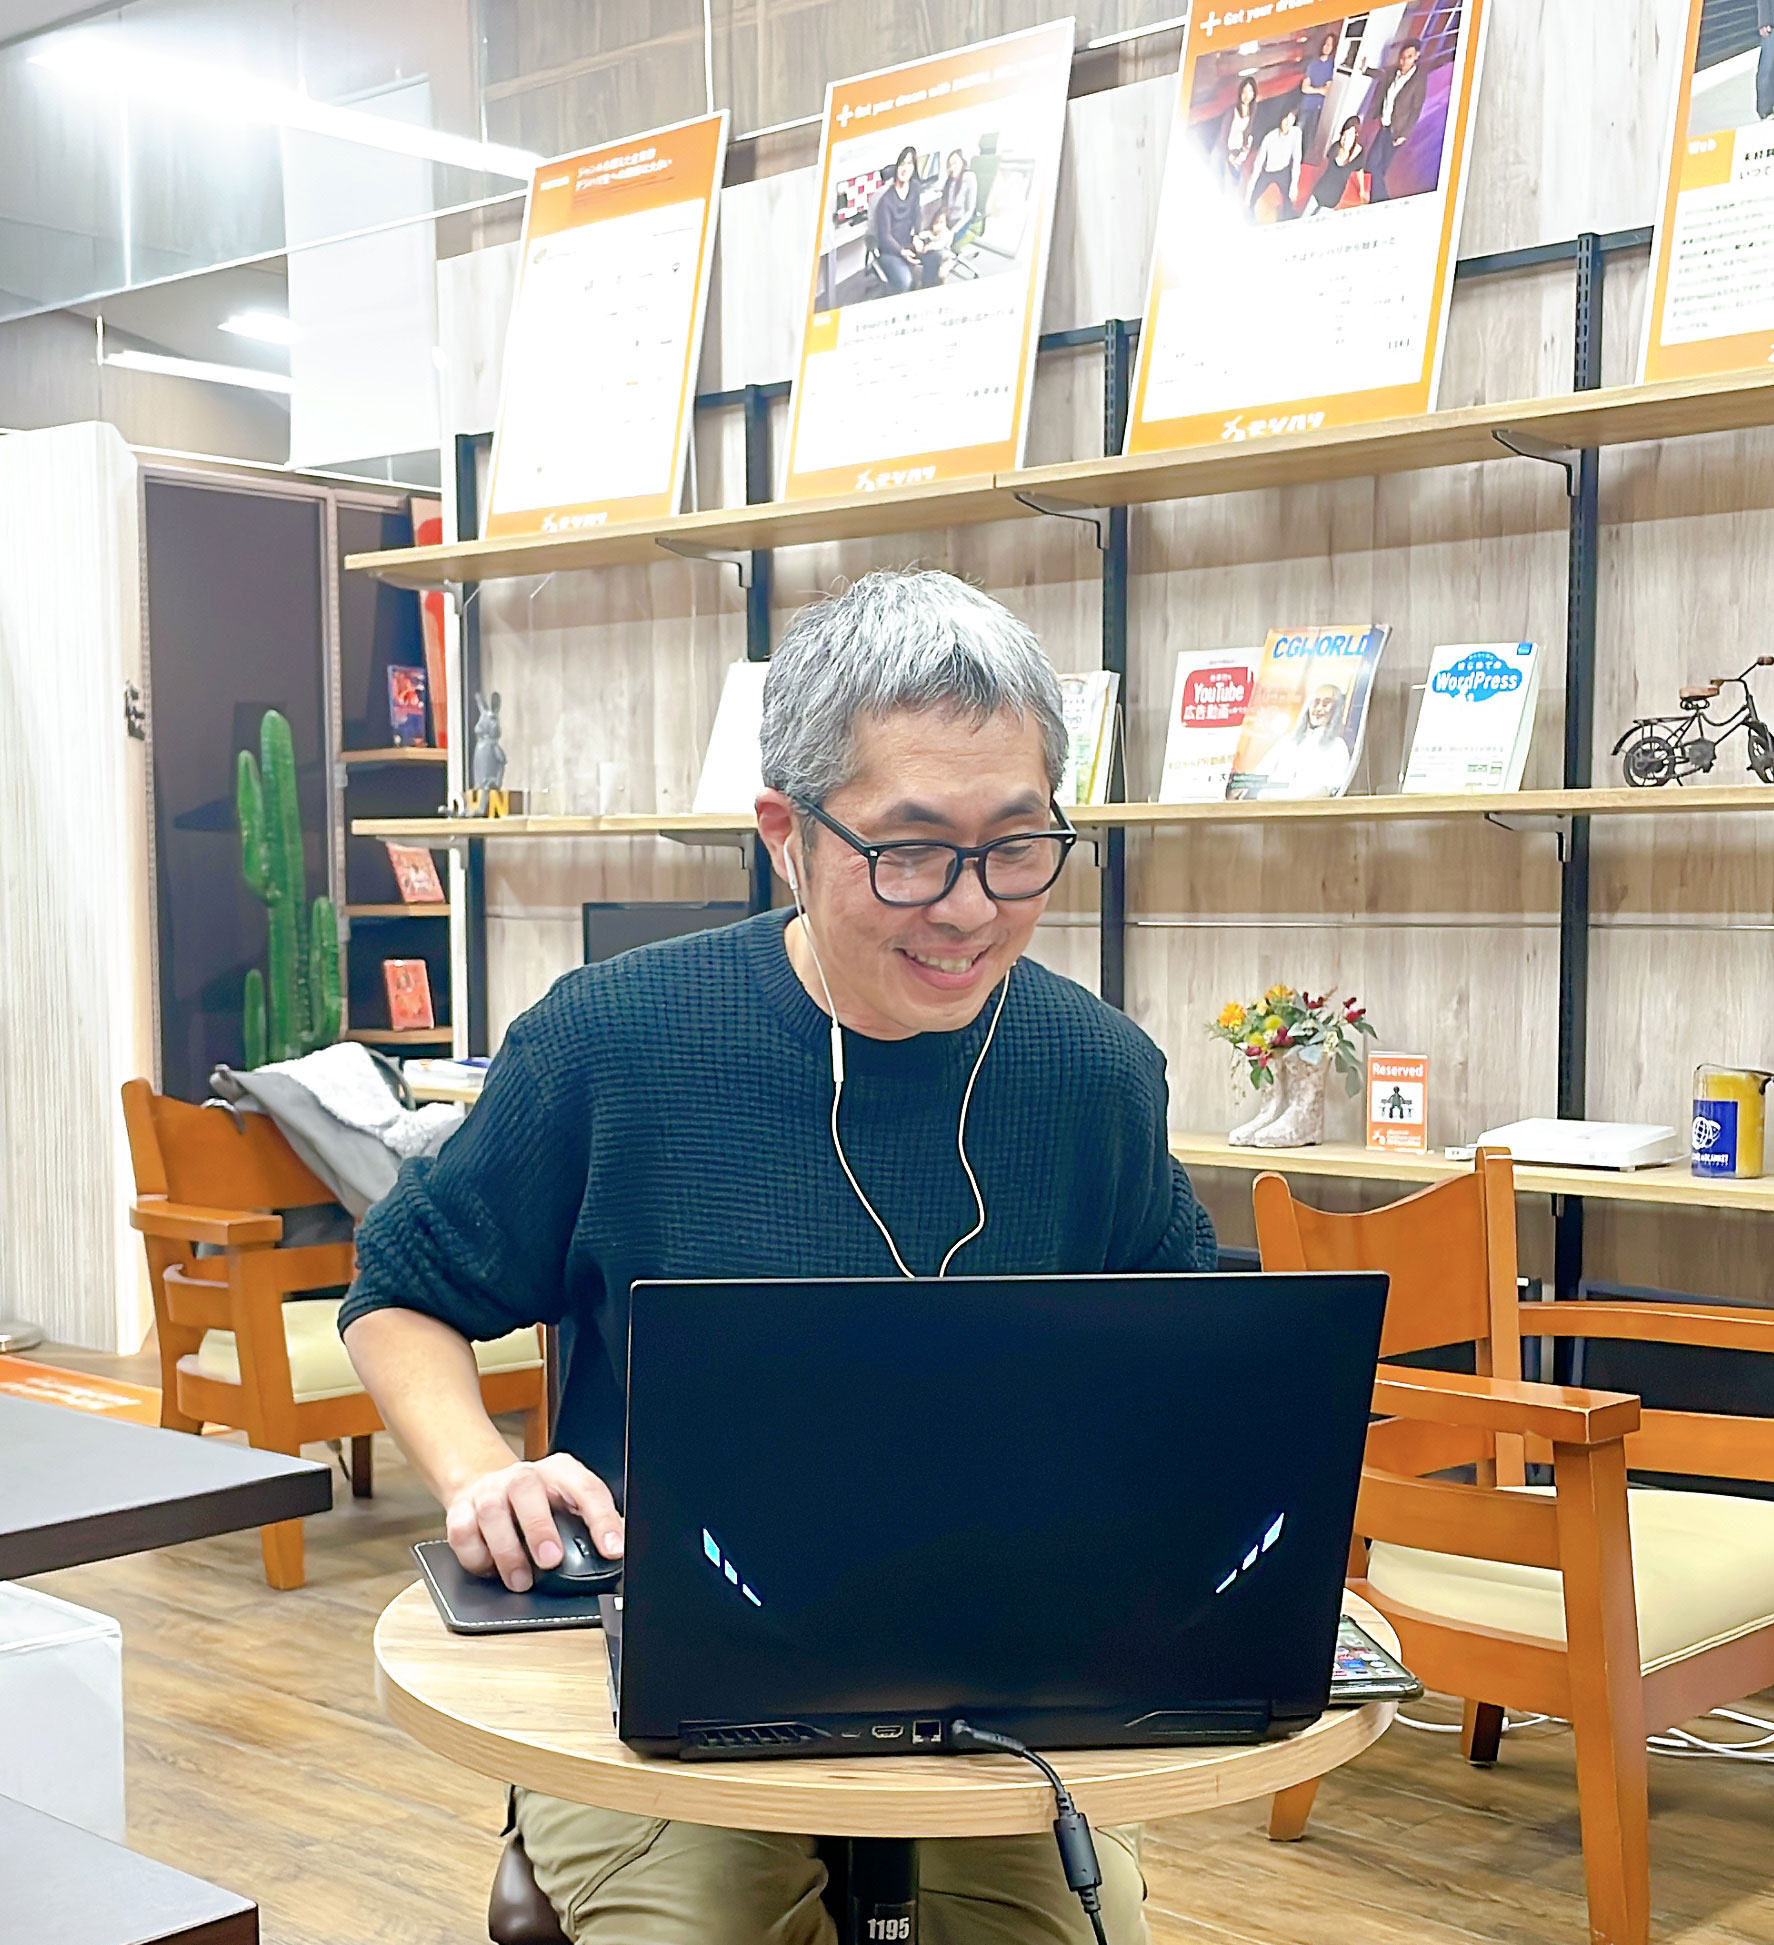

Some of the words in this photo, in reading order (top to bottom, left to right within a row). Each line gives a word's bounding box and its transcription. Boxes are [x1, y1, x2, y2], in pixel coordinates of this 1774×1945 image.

[1246, 4, 1274, 24] your
[1688, 138, 1717, 155] Web
[1273, 635, 1370, 659] CGWORLD
[1435, 671, 1519, 692] WordPress
[1194, 681, 1246, 704] YouTube
[1372, 1062, 1424, 1078] Reserved
[867, 1917, 910, 1940] 1195
